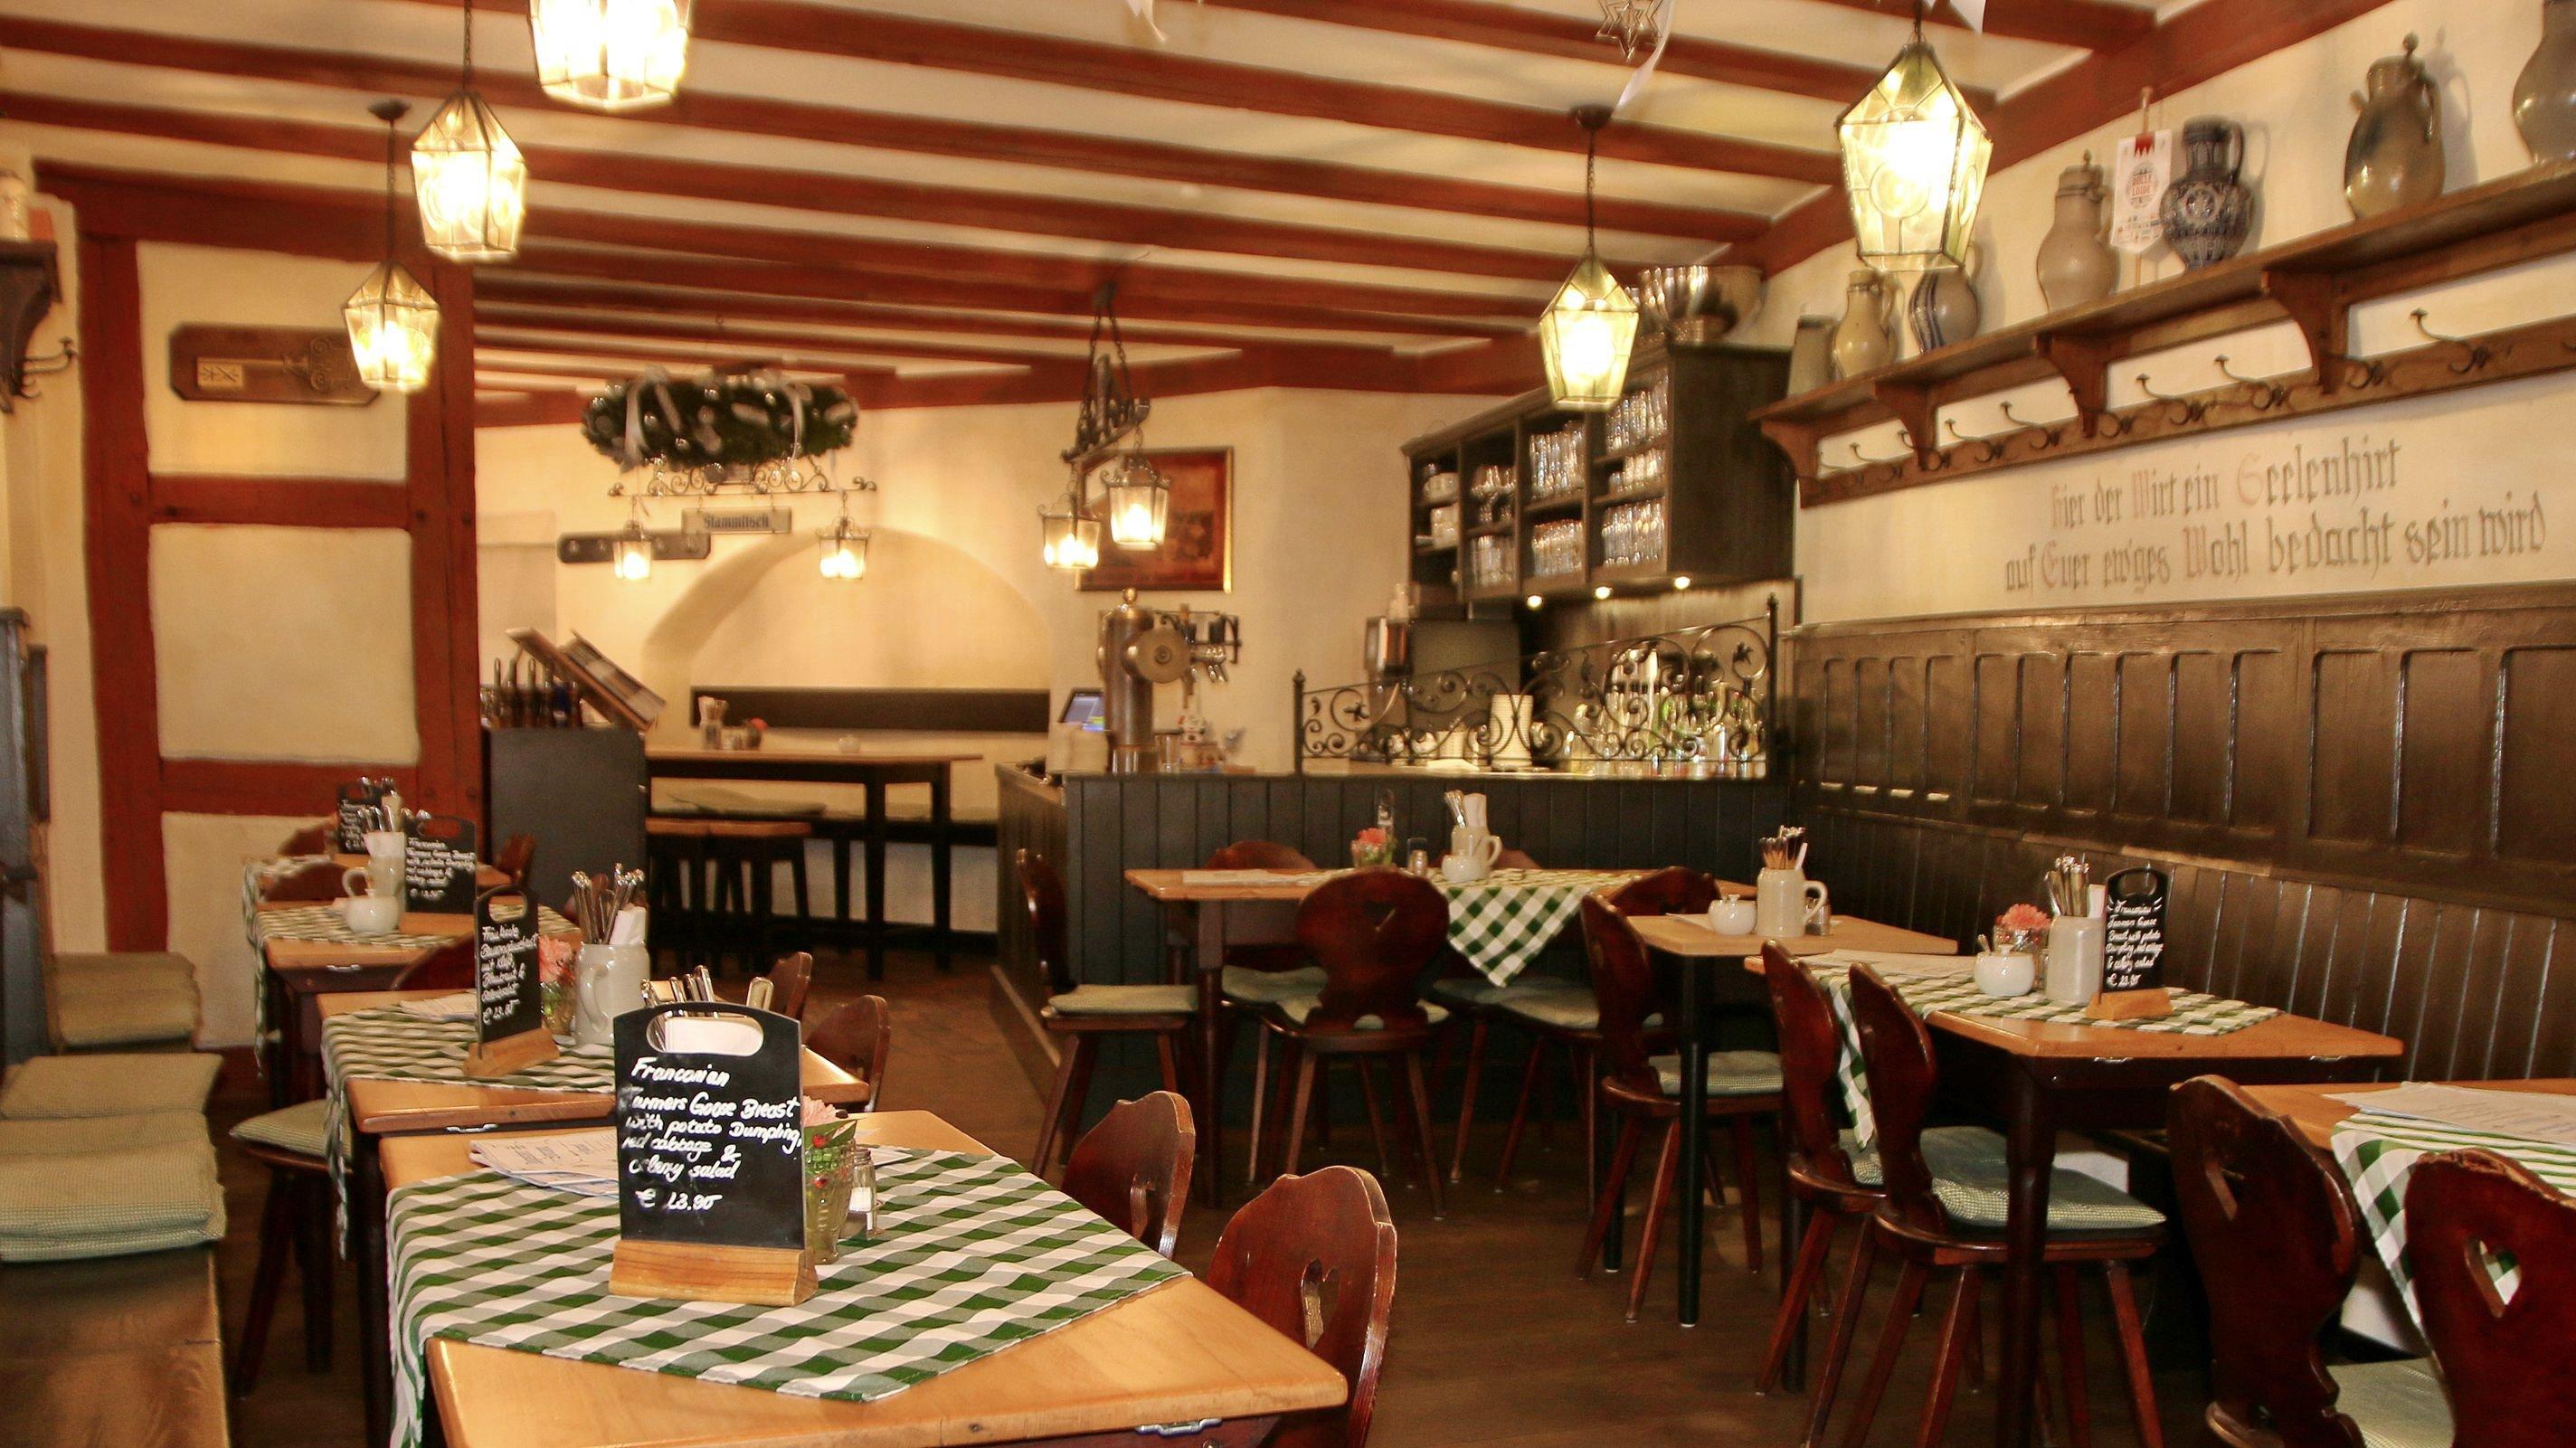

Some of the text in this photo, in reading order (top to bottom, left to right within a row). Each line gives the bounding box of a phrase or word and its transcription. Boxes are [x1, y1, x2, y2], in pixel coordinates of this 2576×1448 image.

[2094, 476, 2122, 525] der
[2184, 462, 2220, 516] ein
[2005, 543, 2037, 597] auf
[2183, 519, 2250, 584] Wohl
[2265, 506, 2396, 580] bedacht
[2404, 497, 2472, 566] sein
[2478, 490, 2547, 556] wird
[631, 1057, 731, 1088] Franconian
[689, 1091, 737, 1118] Goose
[740, 1096, 801, 1121] Breast
[625, 1113, 664, 1131] with
[663, 1119, 723, 1139] potato
[621, 1131, 742, 1163] red cabbage &
[687, 1159, 742, 1179] salad
